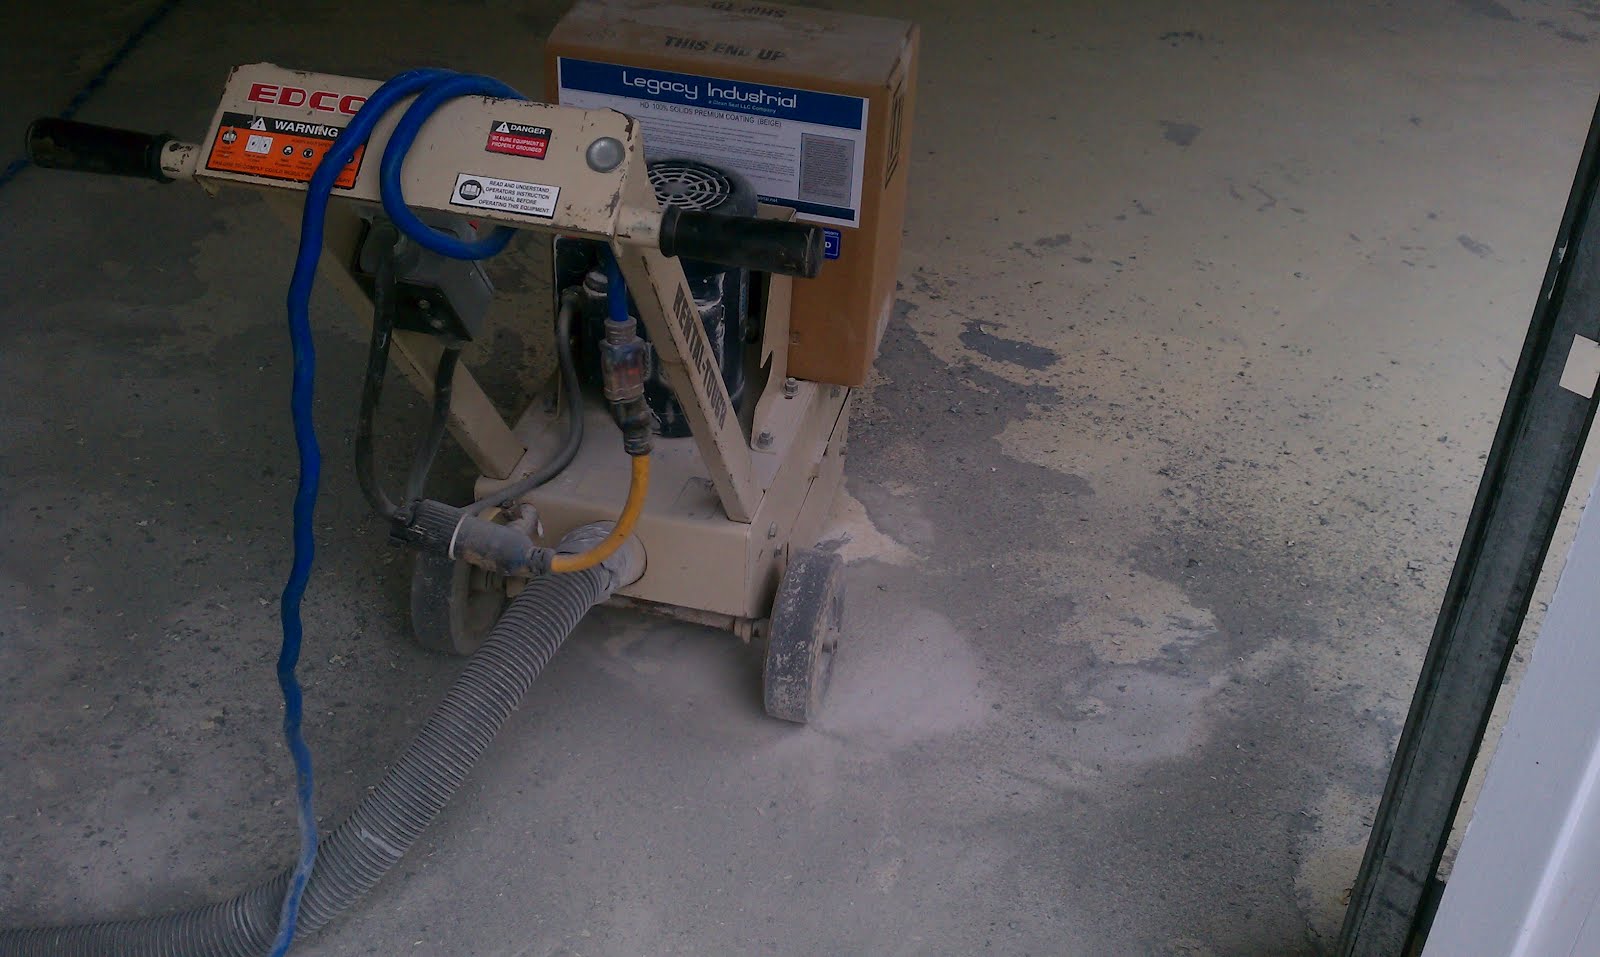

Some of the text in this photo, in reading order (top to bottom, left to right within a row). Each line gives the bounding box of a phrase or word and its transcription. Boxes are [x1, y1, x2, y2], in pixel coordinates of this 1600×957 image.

[664, 35, 709, 51] THIS
[757, 48, 785, 61] UP
[622, 70, 797, 109] Legacy Industrial
[247, 83, 368, 115] EDCO
[713, 99, 727, 107] Clean
[752, 105, 777, 114] Company
[639, 101, 783, 129] HD 100% SOLIDS PREMIUM COATING (BEIGE)
[274, 119, 339, 138] WARNING
[510, 124, 546, 135] DANGER
[491, 141, 543, 153] PROPERLY GROUNDED
[512, 137, 540, 147] EQUIPMENT
[485, 186, 550, 200] OPERATORS INSTRUCTION
[515, 184, 550, 193] UNDERSTAND
[478, 199, 507, 208] OPERATING
[520, 204, 550, 213] EQUIPMENT
[494, 194, 537, 205] MANUAL BEFORE
[673, 282, 728, 431] RENTAL-TOUGH
